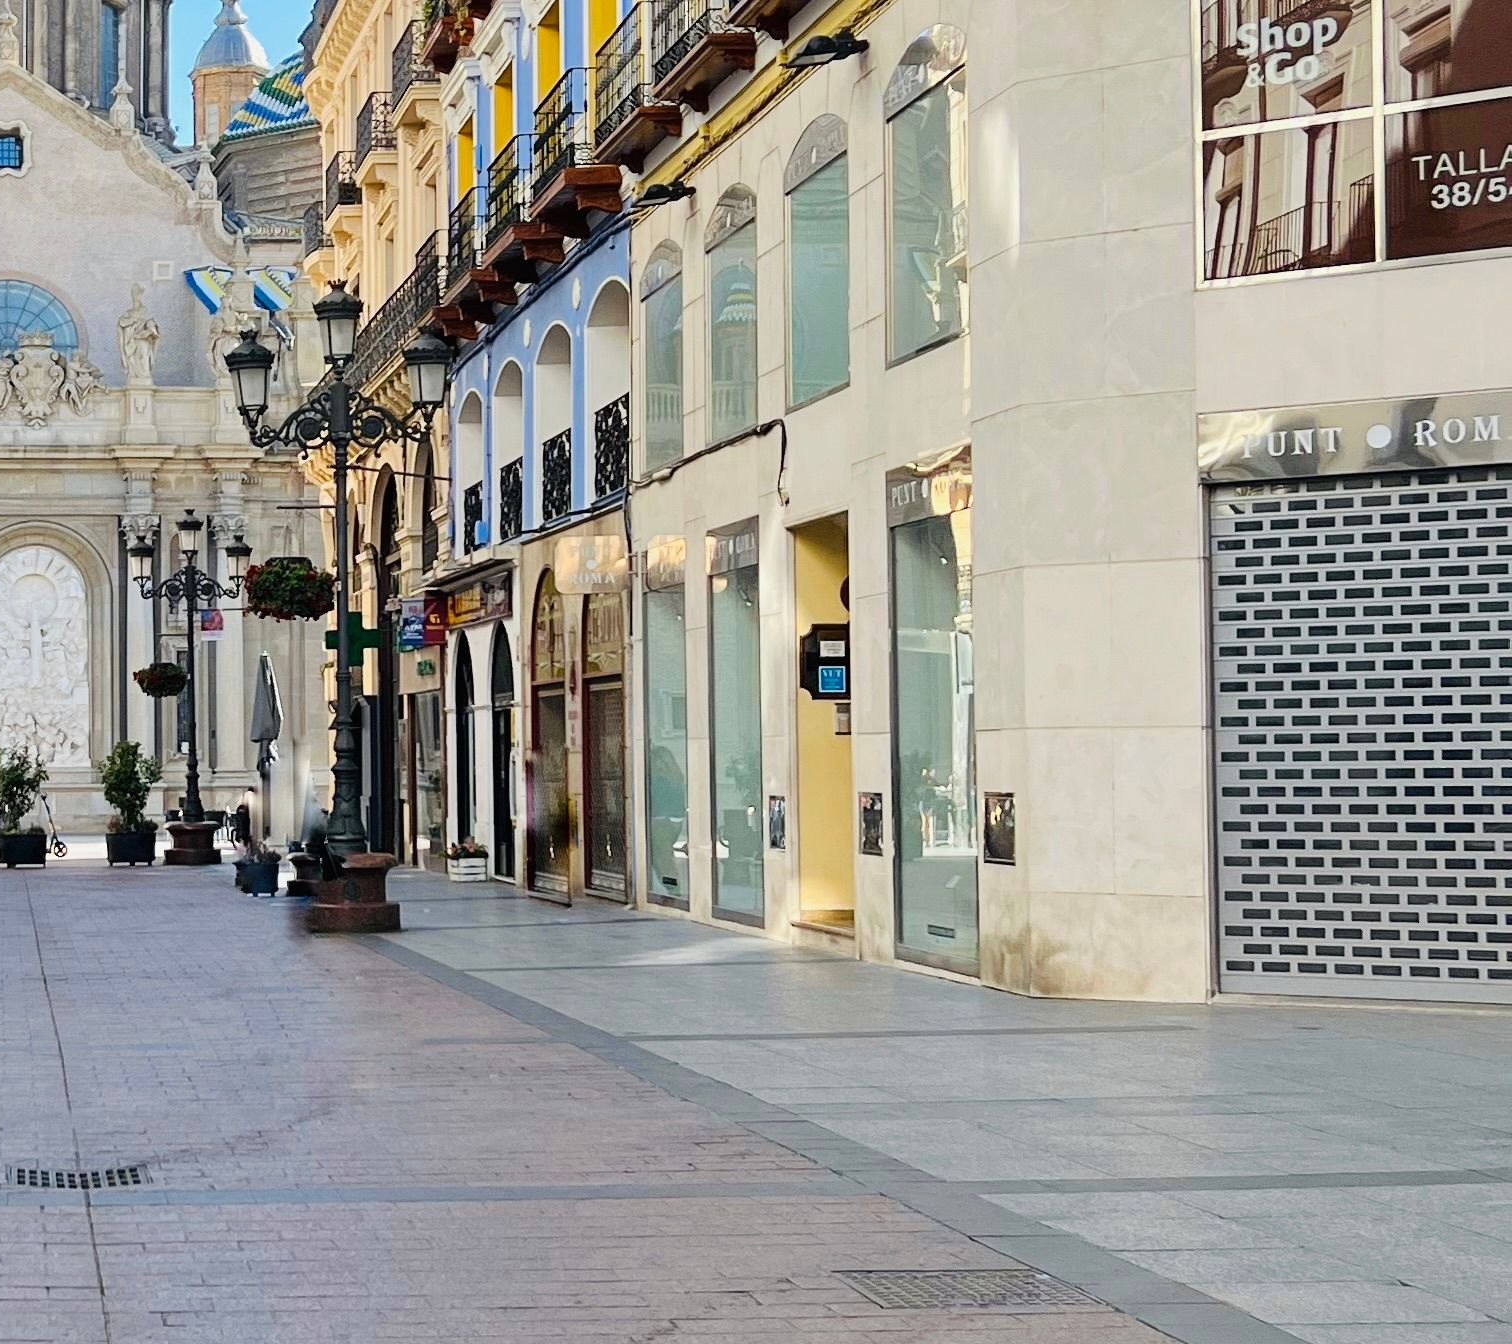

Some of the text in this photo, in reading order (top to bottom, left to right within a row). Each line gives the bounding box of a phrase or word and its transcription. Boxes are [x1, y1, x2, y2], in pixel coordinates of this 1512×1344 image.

[1236, 15, 1339, 57] Shop
[1244, 51, 1322, 89] &Go
[1430, 176, 1512, 210] 38/5
[1240, 414, 1512, 459] PUNT ROM
